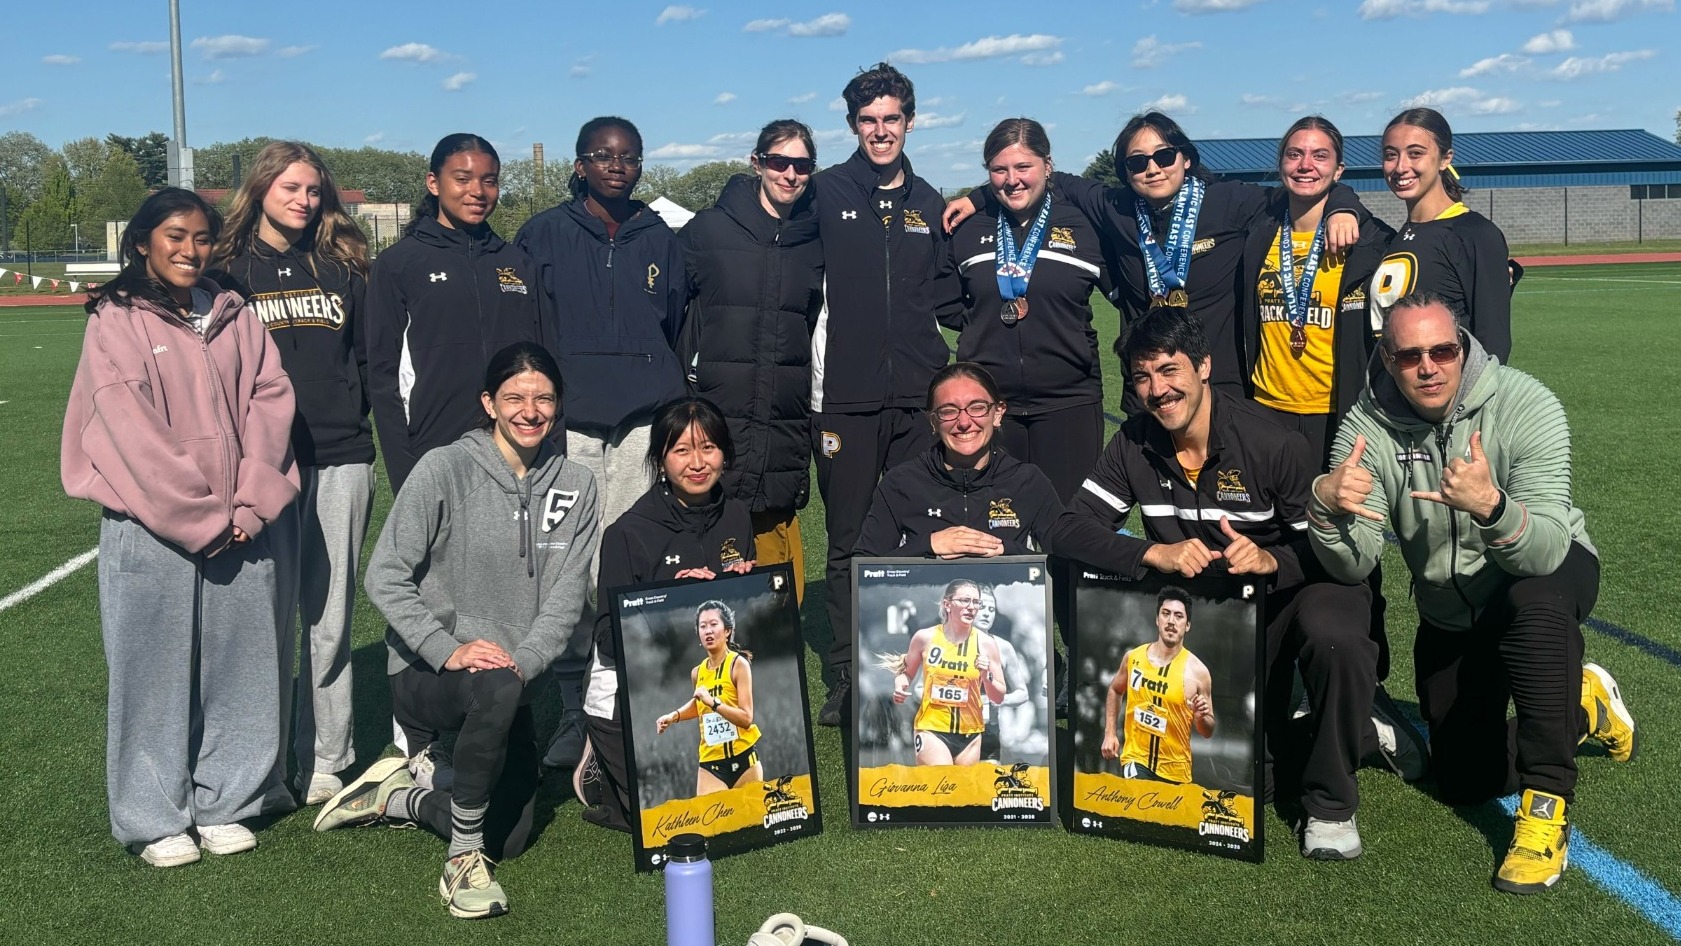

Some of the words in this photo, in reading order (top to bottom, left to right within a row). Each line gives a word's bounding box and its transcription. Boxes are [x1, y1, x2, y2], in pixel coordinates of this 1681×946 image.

[1037, 209, 1049, 229] EAST
[1185, 206, 1196, 230] EAST
[1004, 221, 1017, 262] CONFERENCE
[1168, 222, 1180, 246] EAST
[1019, 228, 1041, 267] CONFERENCE
[1177, 230, 1192, 277] CONFERENCE
[1282, 250, 1292, 272] EAST
[1306, 254, 1319, 277] EAST
[1283, 272, 1298, 315] ATLANTIC
[248, 295, 344, 324] ANNONEERS
[1307, 307, 1332, 329] ELD
[820, 430, 842, 459] P
[773, 575, 784, 590] P
[1028, 567, 1041, 581] P
[1242, 584, 1255, 599] P
[928, 647, 942, 665] 9
[939, 658, 969, 673] ratt
[1132, 669, 1142, 688] 7
[938, 688, 962, 701] 165
[708, 721, 732, 736] 2432
[1139, 711, 1161, 729] 152
[915, 734, 923, 753] 9
[731, 762, 740, 772] P
[869, 778, 928, 798] Giovanna
[1084, 786, 1137, 811] Anthony
[1137, 792, 1183, 811] Cowell
[991, 796, 1044, 812] CANNONEERS
[652, 810, 700, 839] Kathleen
[701, 802, 735, 827] Chen
[763, 805, 809, 829] CANNONEERS
[1198, 821, 1250, 843] CANNONEERS
